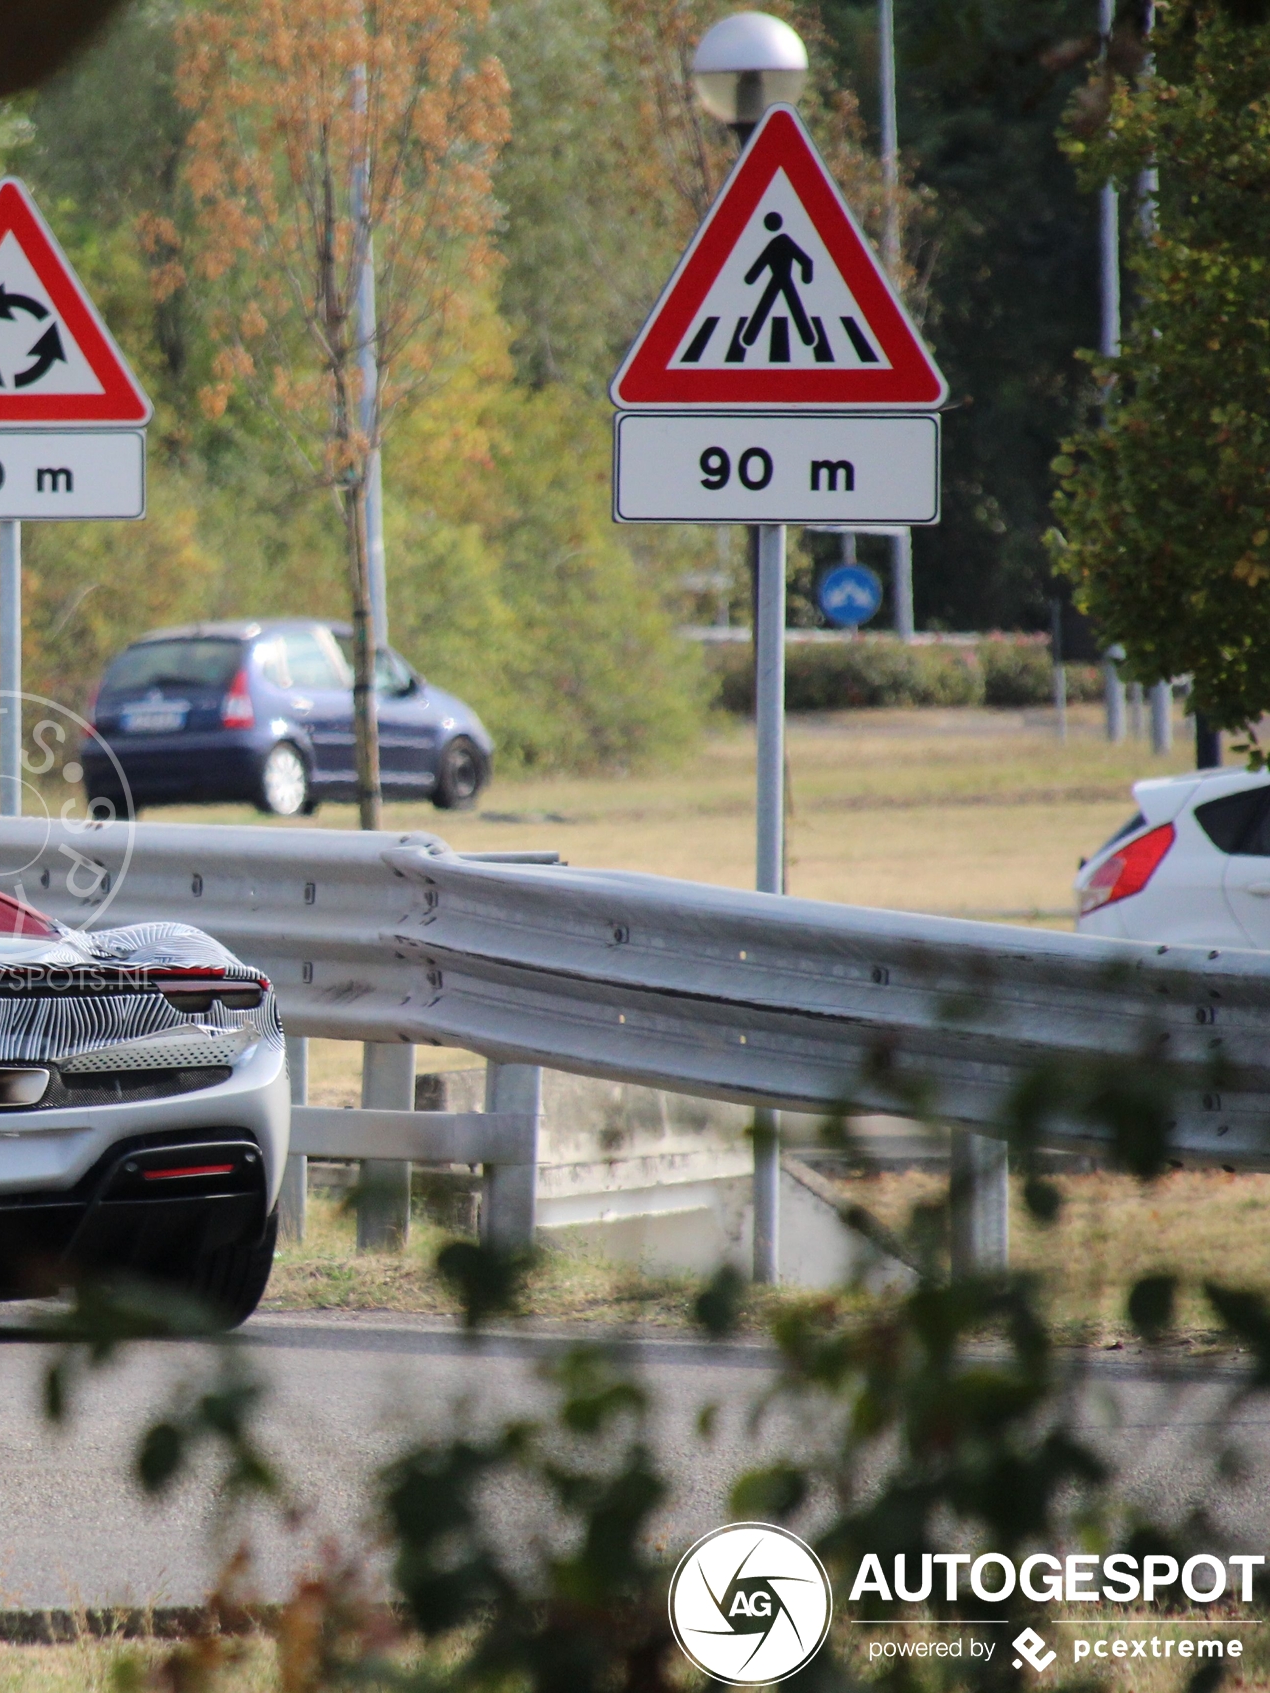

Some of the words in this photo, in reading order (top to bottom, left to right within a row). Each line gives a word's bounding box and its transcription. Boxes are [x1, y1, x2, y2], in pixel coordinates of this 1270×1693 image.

[36, 466, 73, 493] m
[699, 446, 774, 491] 90
[810, 459, 855, 491] m
